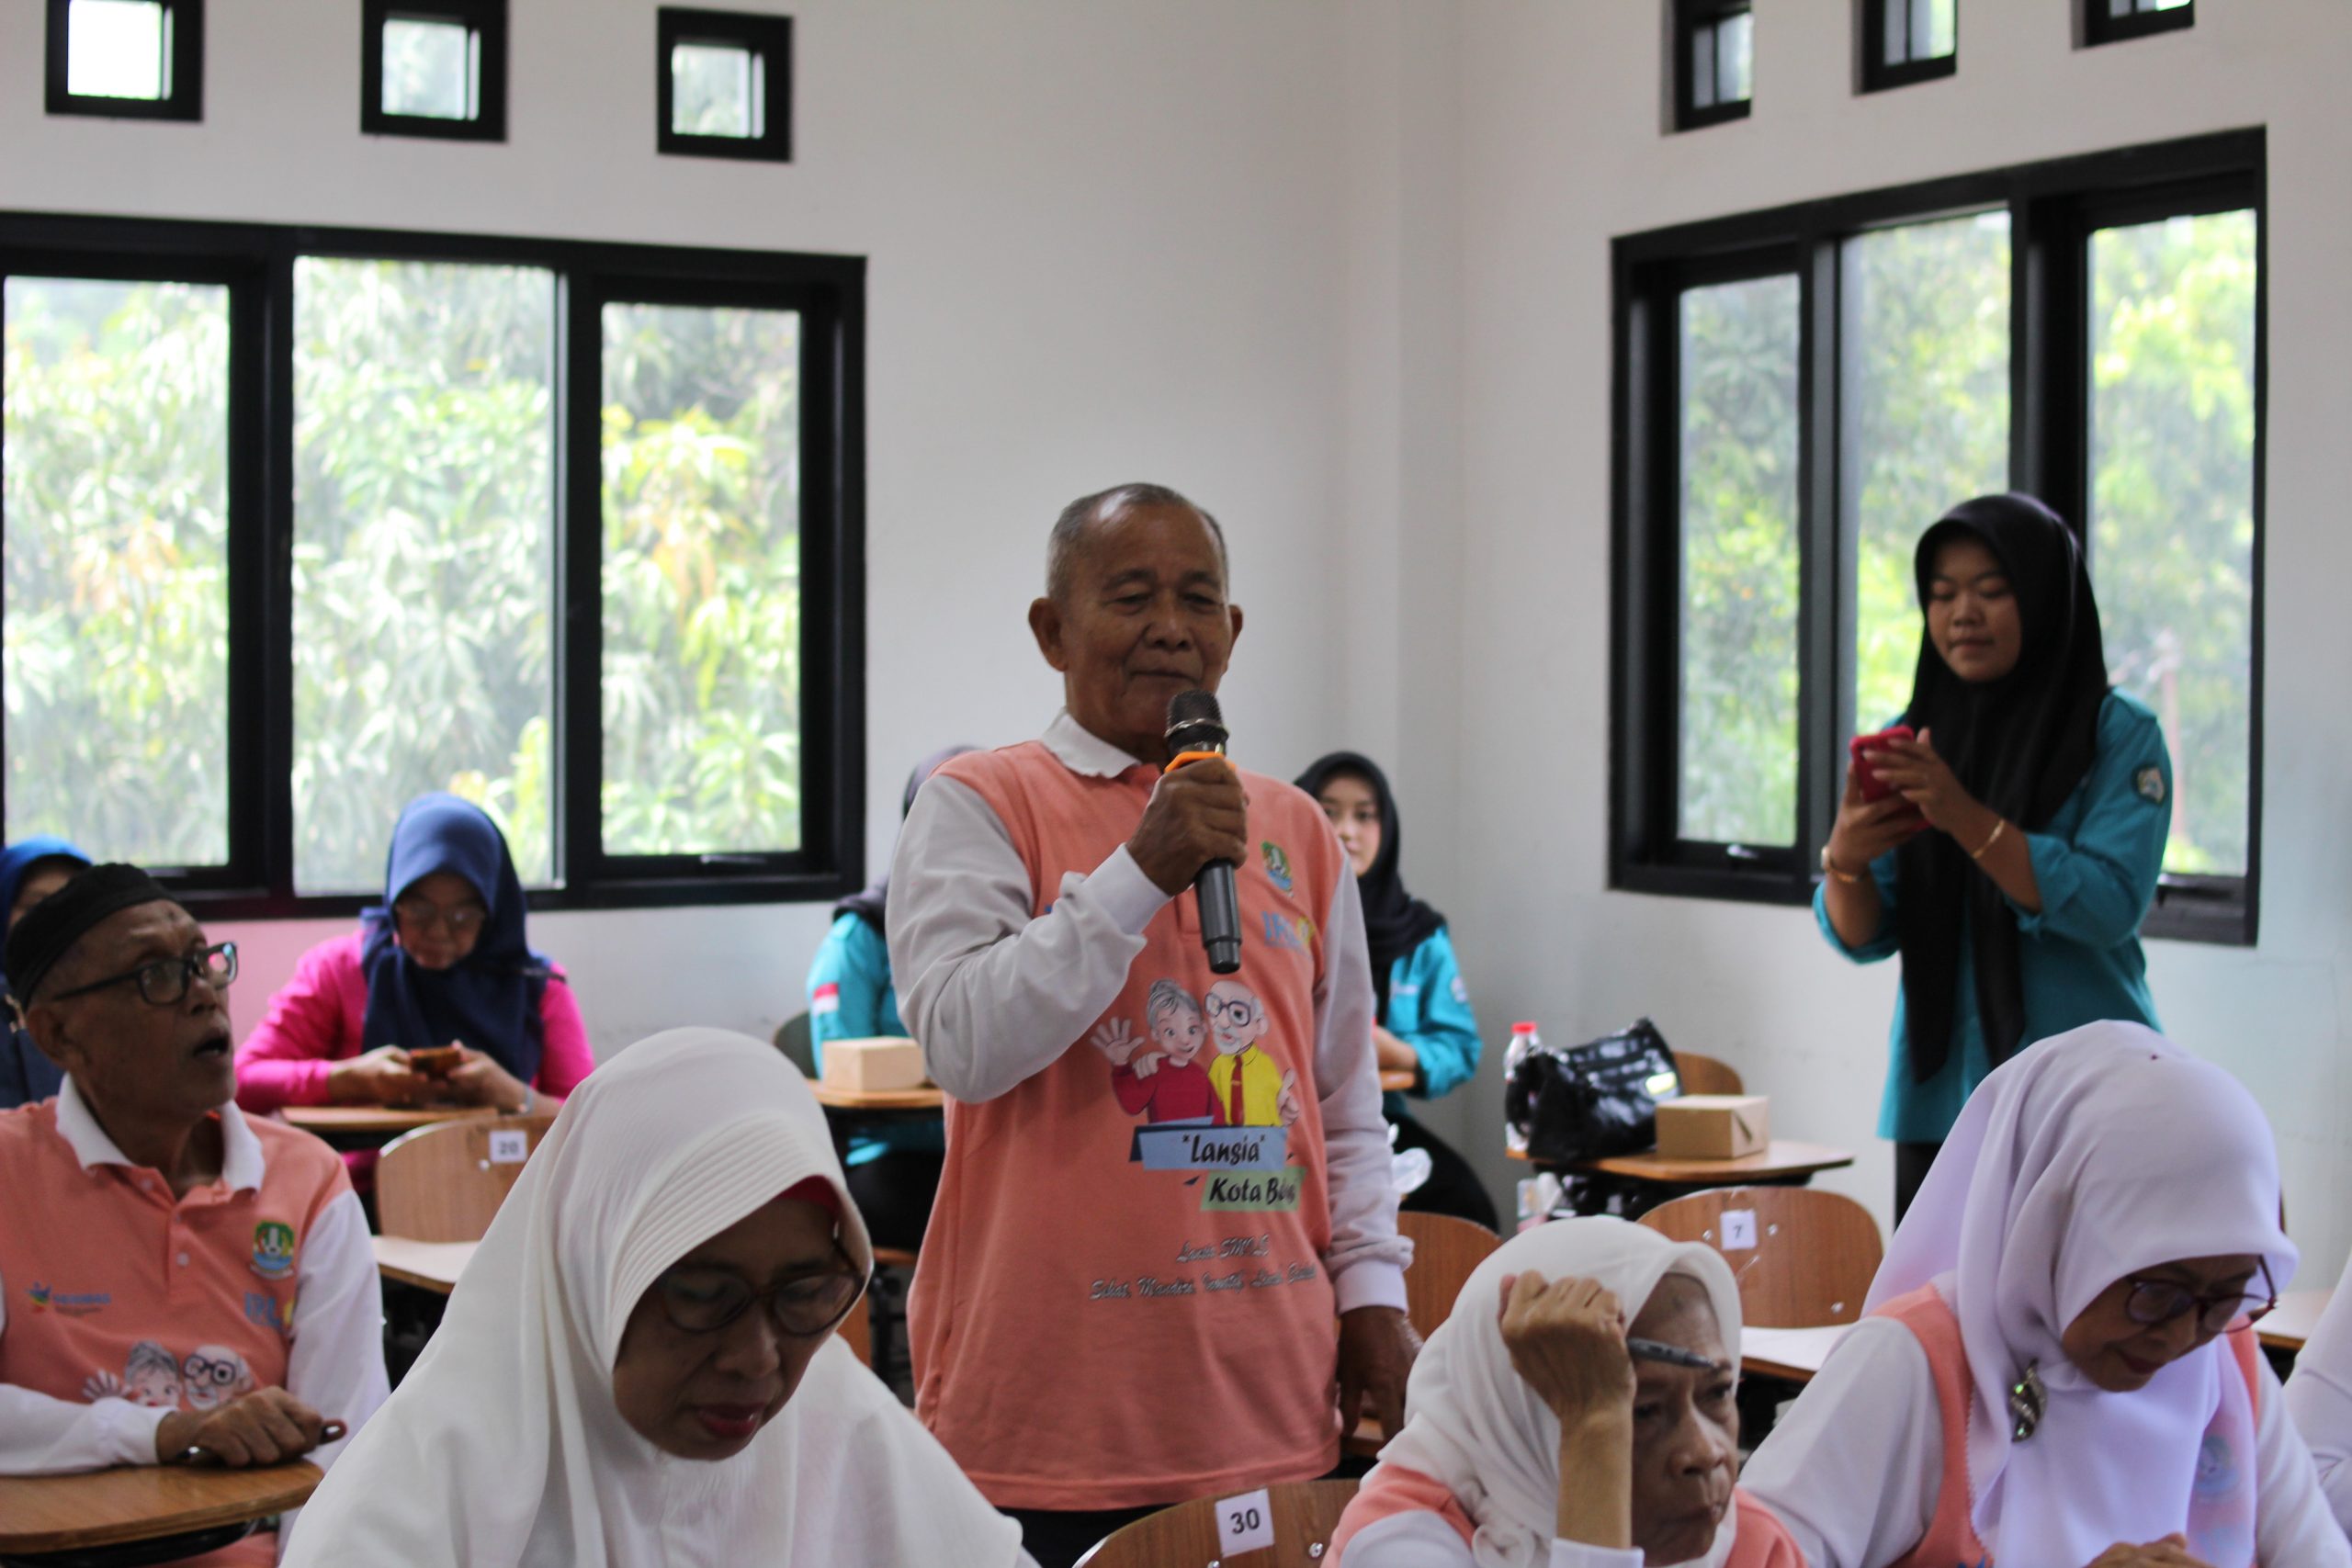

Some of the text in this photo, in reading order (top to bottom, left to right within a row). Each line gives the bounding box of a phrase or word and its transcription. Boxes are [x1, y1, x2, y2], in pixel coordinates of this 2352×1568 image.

[1209, 1178, 1261, 1203] Kota
[1733, 1224, 1744, 1239] 7
[1230, 1508, 1260, 1534] 30
